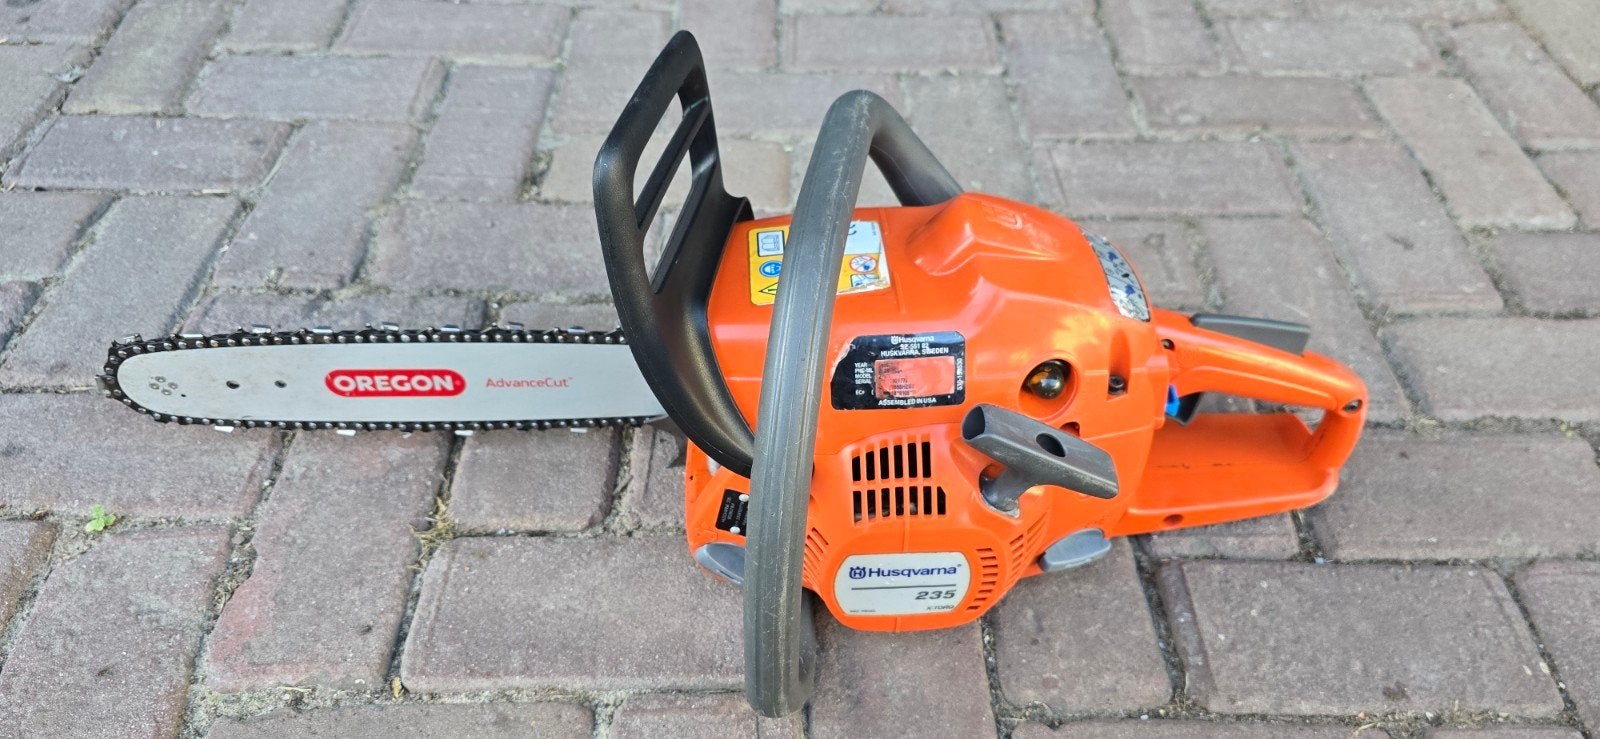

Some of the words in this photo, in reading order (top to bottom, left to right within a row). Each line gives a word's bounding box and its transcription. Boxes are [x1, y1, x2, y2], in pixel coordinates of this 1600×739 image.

[922, 347, 949, 355] SWEDEN
[334, 375, 455, 392] OREGON
[878, 398, 916, 406] ASSEMBLED
[915, 589, 956, 600] 235
